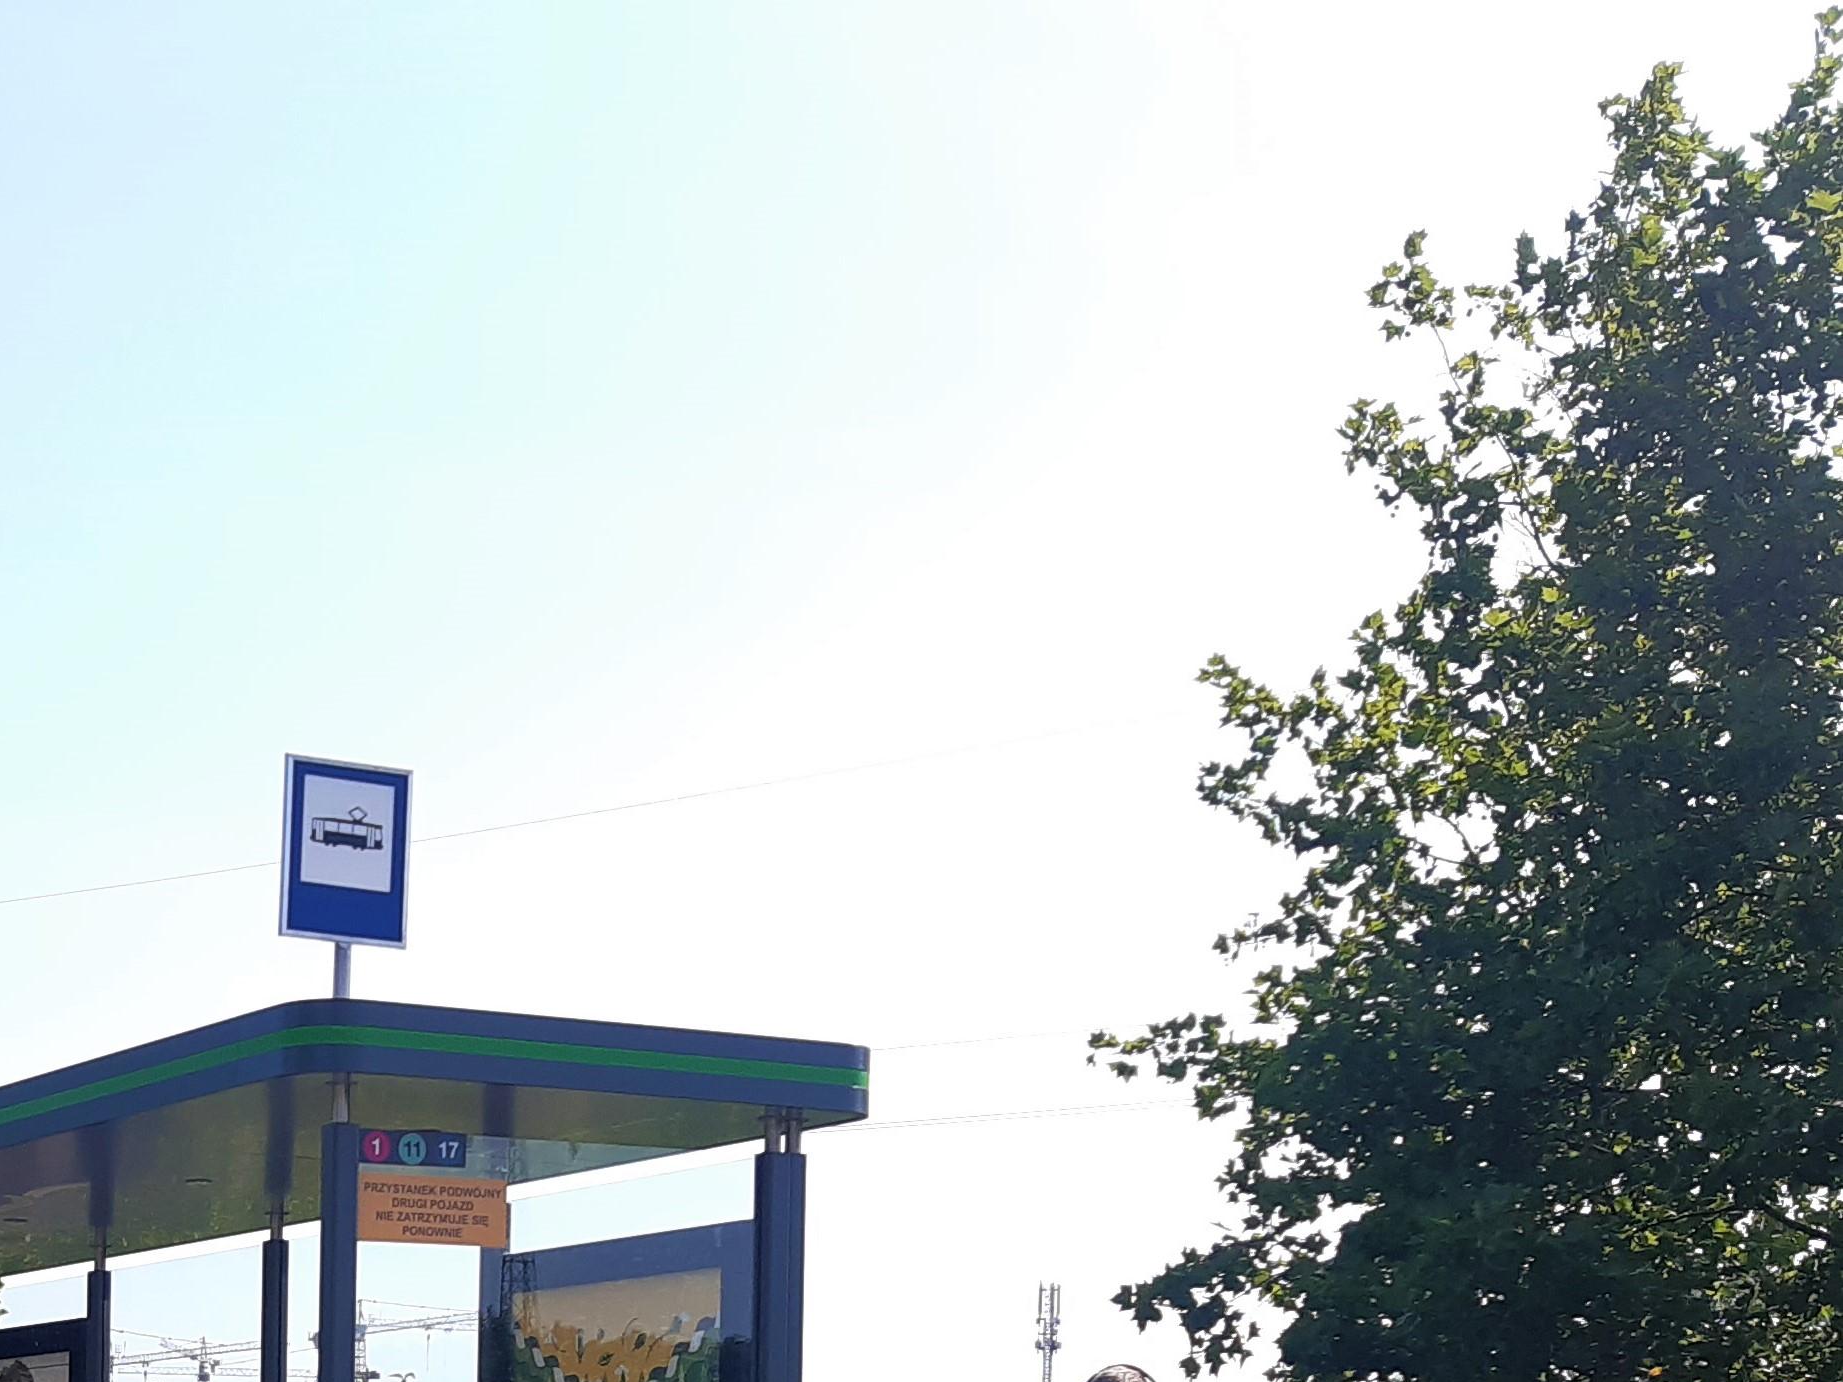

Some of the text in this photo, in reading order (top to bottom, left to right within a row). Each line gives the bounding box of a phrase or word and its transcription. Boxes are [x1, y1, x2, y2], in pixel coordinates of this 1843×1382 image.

[371, 1138, 459, 1159] 1 11 17
[364, 1182, 502, 1199] PRZYSTANEK PODWÓJNY
[391, 1198, 474, 1211] DRUGI POJAZD
[375, 1211, 489, 1227] NIE ZATRZYMUJE SIĘ
[402, 1226, 463, 1238] PONOWNIE
